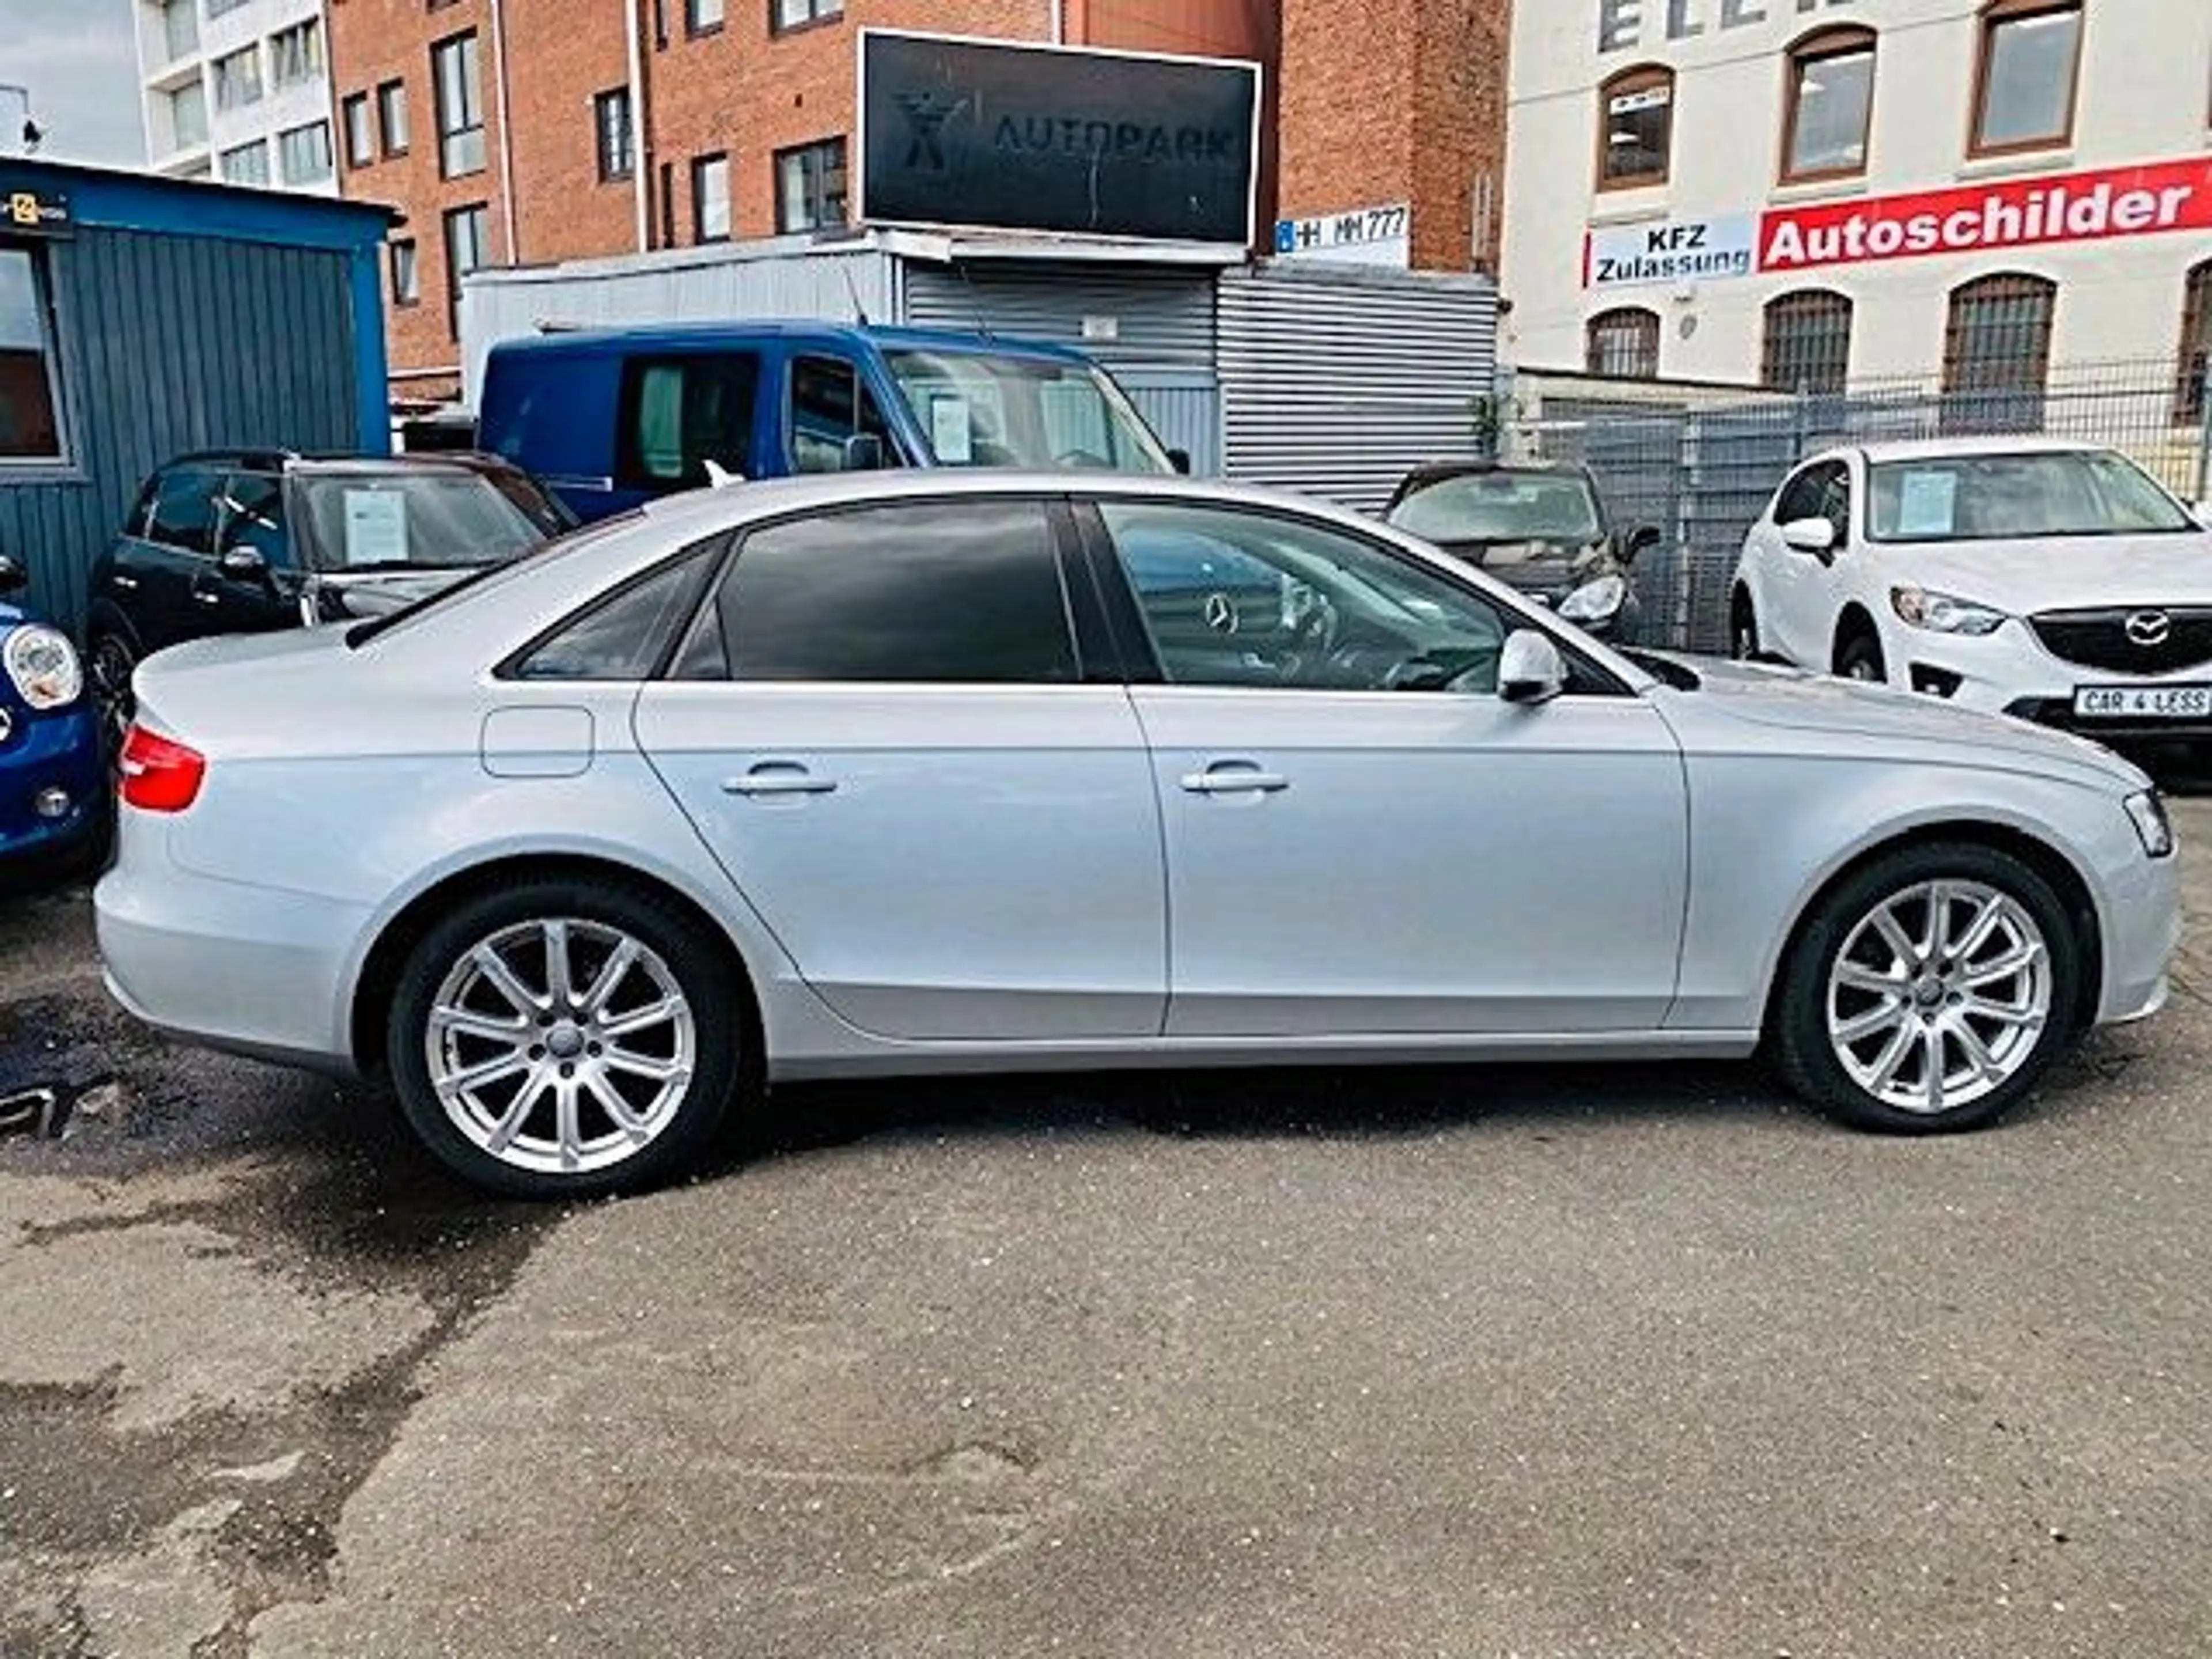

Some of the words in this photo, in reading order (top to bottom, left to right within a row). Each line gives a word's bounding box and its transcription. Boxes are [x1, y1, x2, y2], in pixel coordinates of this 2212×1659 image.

[994, 115, 1233, 160] AUTOPARK
[1647, 224, 1707, 253] KFZ
[1764, 181, 2192, 265] Autoschilder
[1596, 249, 1752, 282] Zulassung
